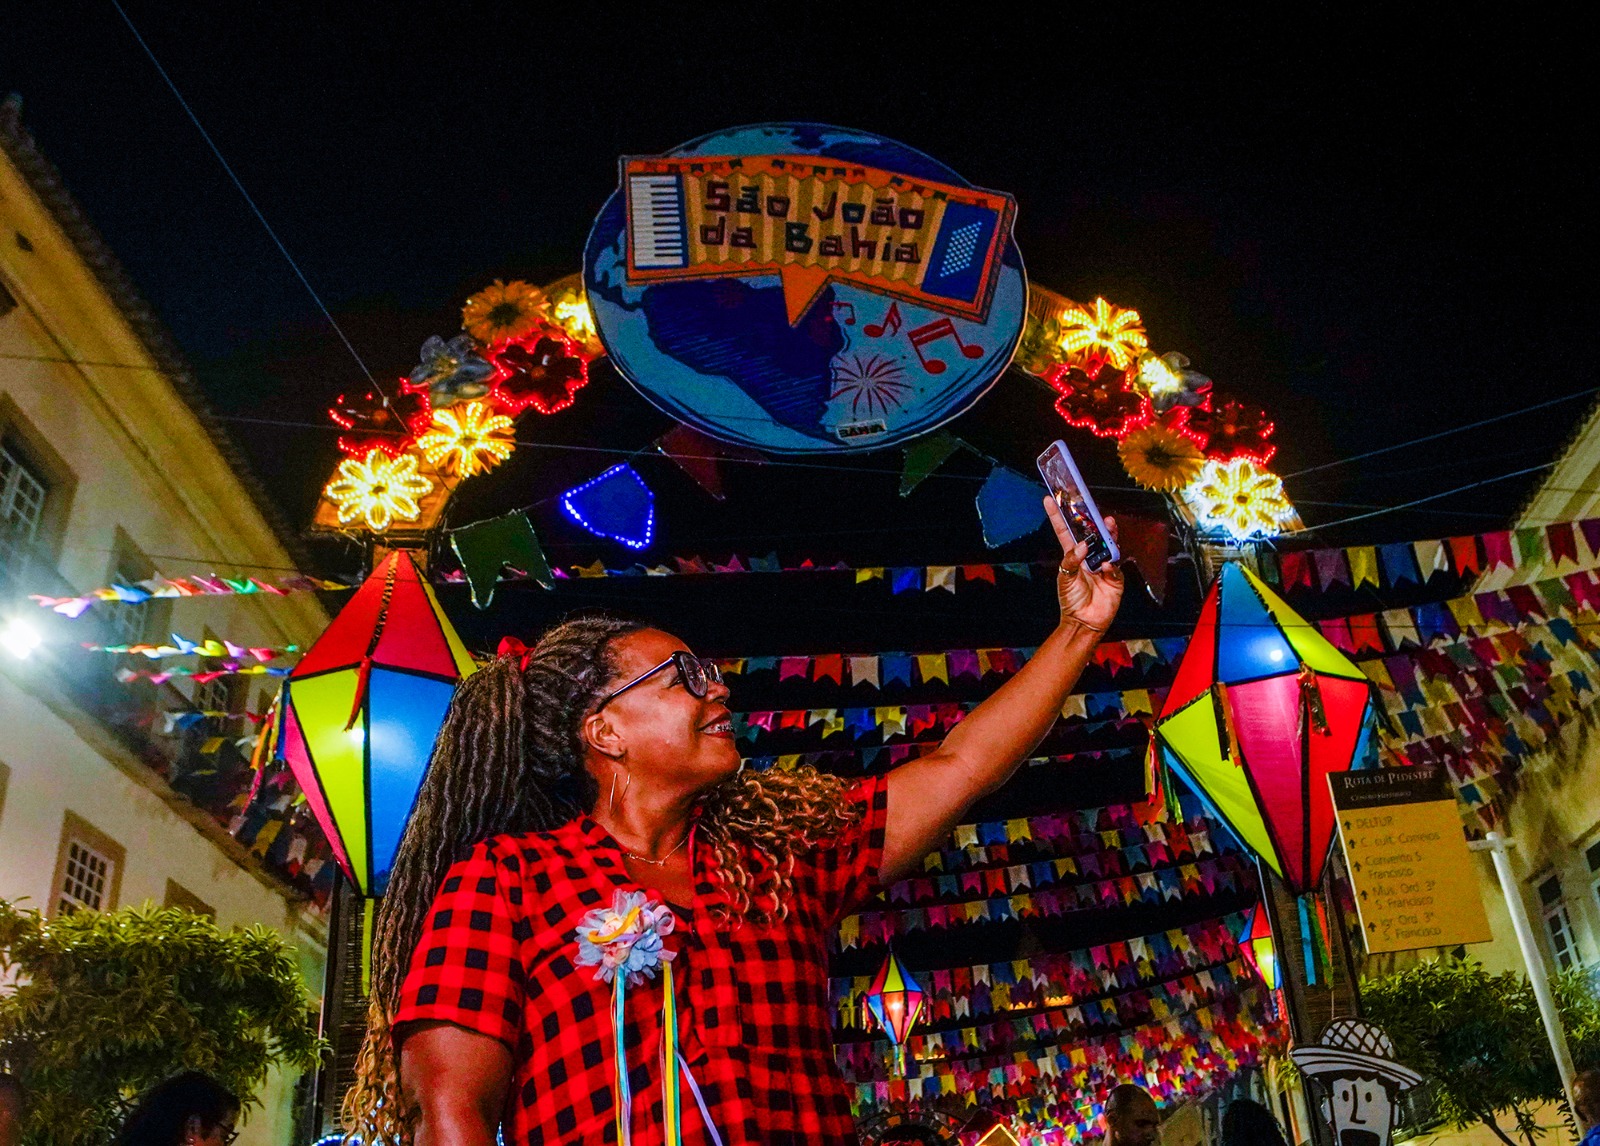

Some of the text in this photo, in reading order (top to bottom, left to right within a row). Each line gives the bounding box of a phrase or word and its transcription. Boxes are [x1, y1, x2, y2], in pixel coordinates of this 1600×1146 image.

[704, 180, 924, 230] São João
[700, 216, 921, 263] da Bahia
[1368, 868, 1414, 879] Francisco
[1388, 896, 1433, 907] Francisco
[1395, 927, 1441, 938] Francisco
